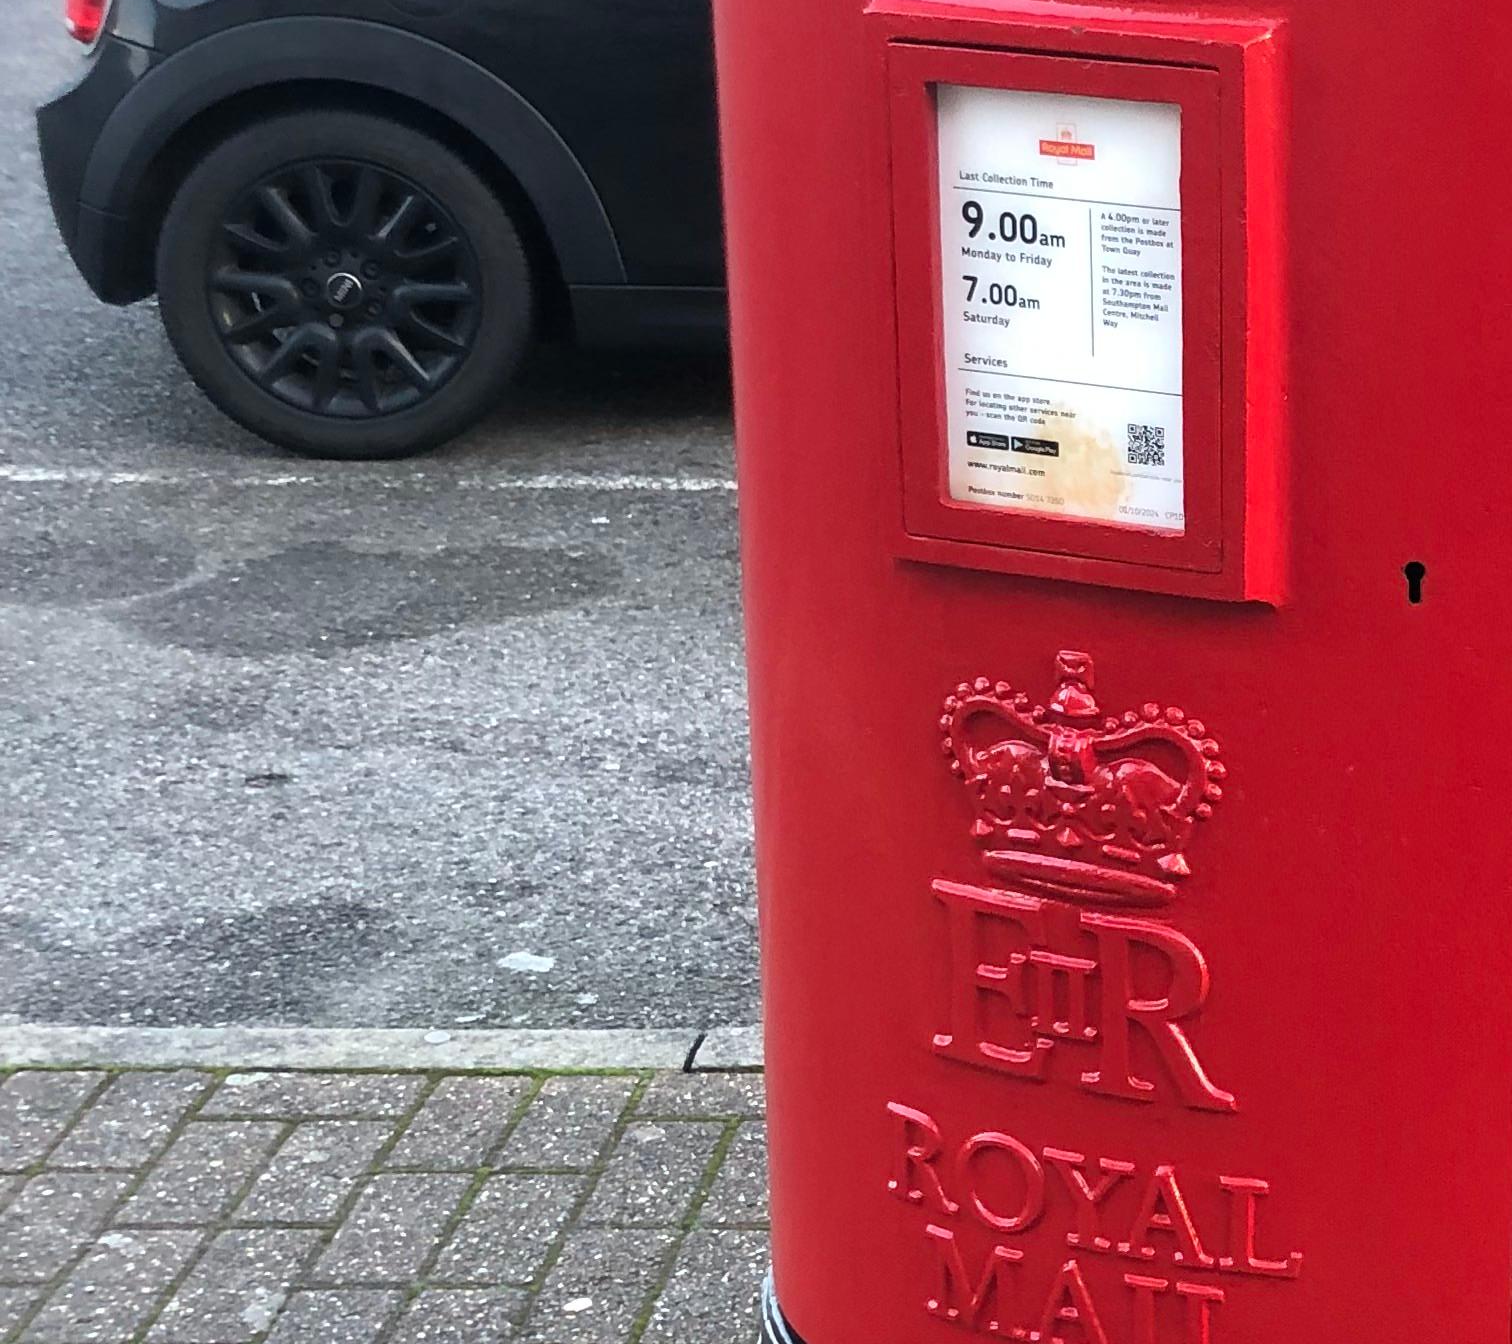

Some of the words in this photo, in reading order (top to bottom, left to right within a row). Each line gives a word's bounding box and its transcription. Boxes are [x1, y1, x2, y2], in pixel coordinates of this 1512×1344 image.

[1041, 142, 1069, 156] Royal
[1071, 144, 1093, 157] Mail
[960, 170, 980, 182] Last
[983, 172, 1028, 187] Collection
[1030, 177, 1054, 190] Time
[961, 201, 1066, 248] 9.00am
[1101, 224, 1136, 234] collection
[1121, 236, 1133, 244] the
[961, 246, 1002, 263] Monday
[1005, 252, 1016, 263] to
[1019, 252, 1053, 269] Friday
[962, 275, 1041, 310] 7.00am
[963, 310, 1011, 329] Saturday
[964, 352, 1009, 369] Services
[887, 1101, 1302, 1278] ROYAL
